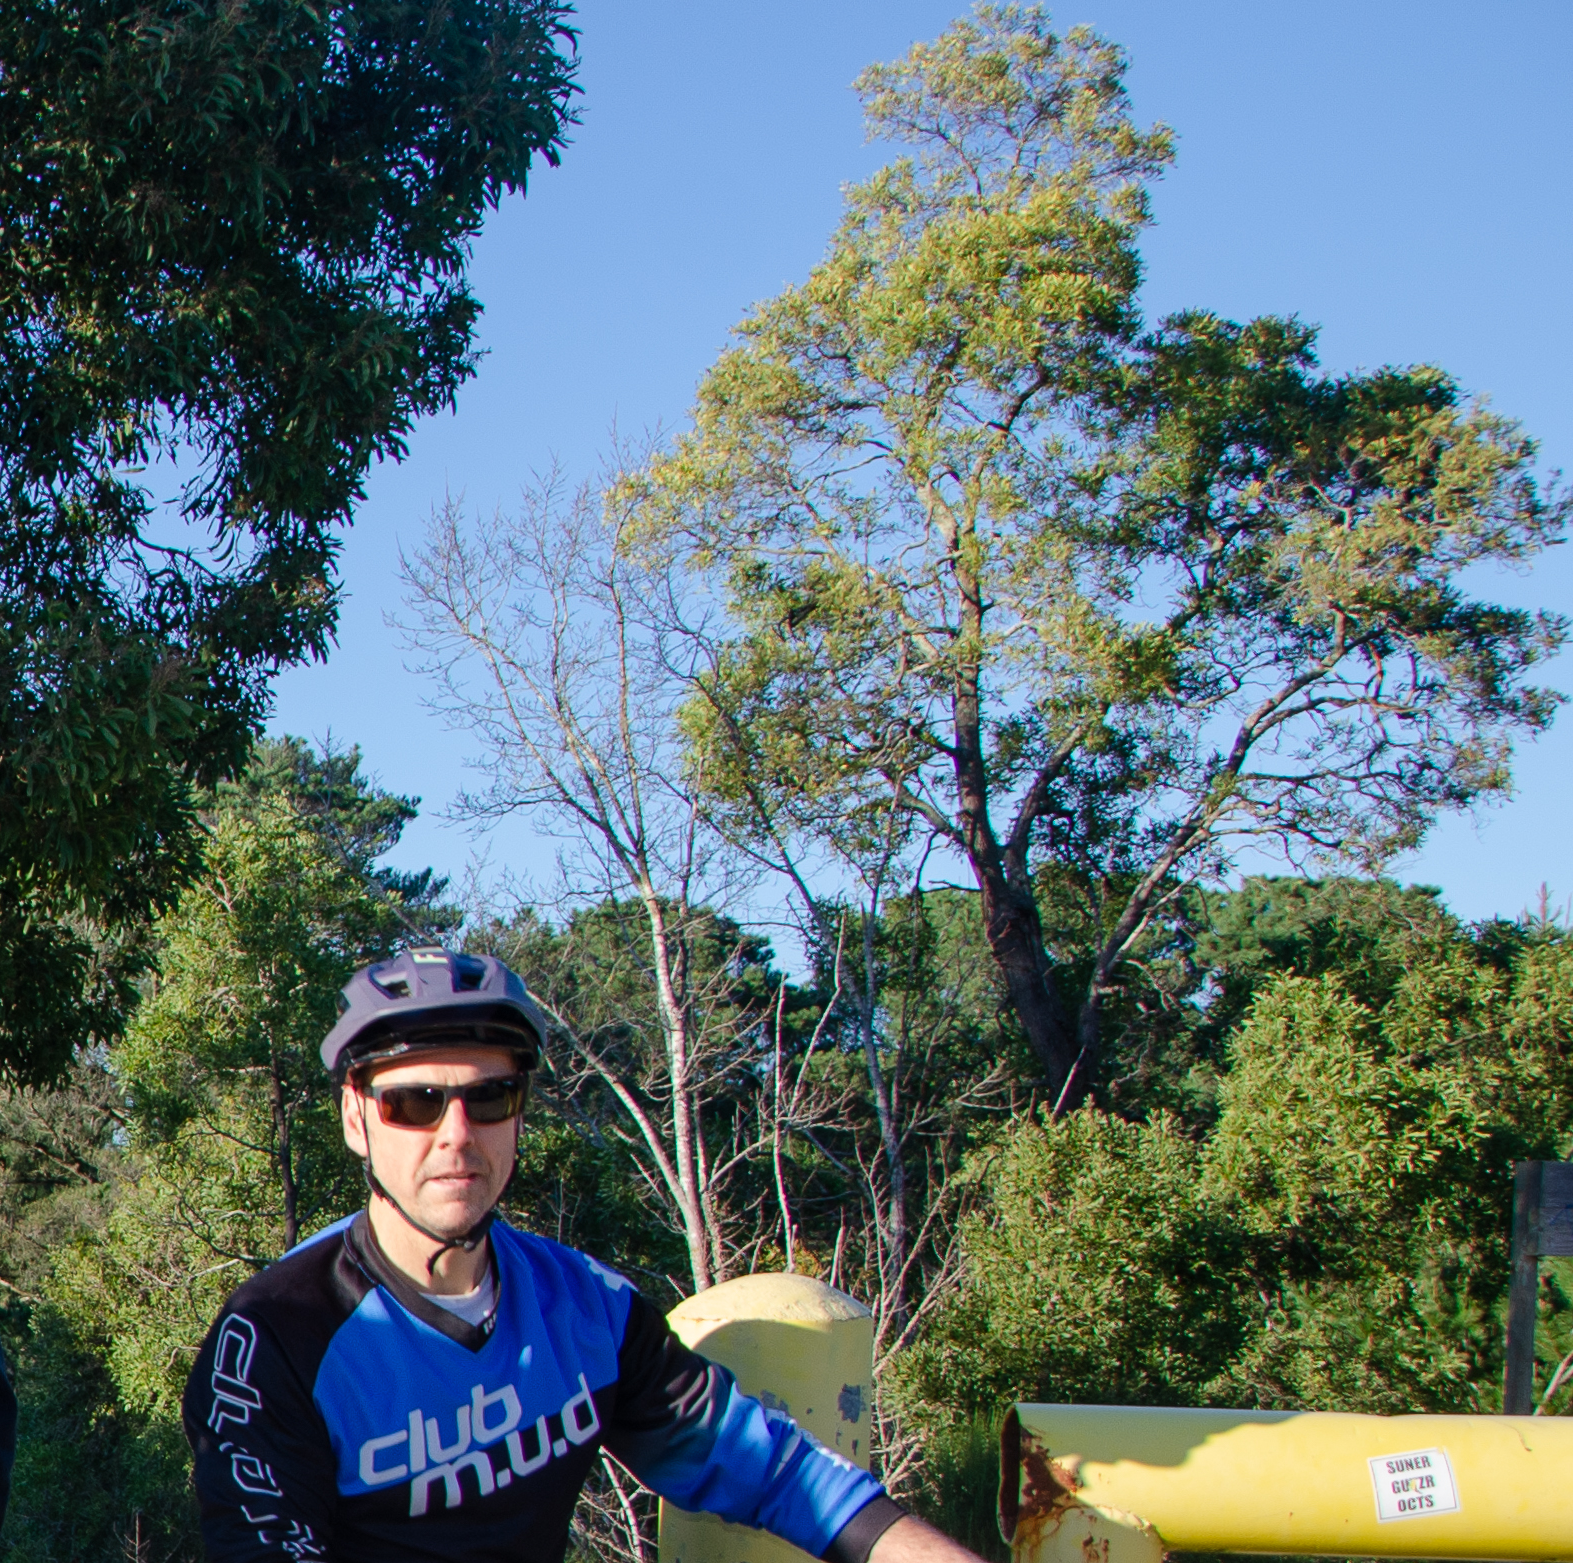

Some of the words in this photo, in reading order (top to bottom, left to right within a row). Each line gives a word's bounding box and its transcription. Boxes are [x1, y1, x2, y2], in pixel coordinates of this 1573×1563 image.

[359, 1383, 523, 1486] club
[409, 1372, 601, 1517] m.u.d
[1386, 1455, 1432, 1474] SUNER
[1391, 1474, 1436, 1494] GUZR
[1397, 1494, 1435, 1512] OCTS
